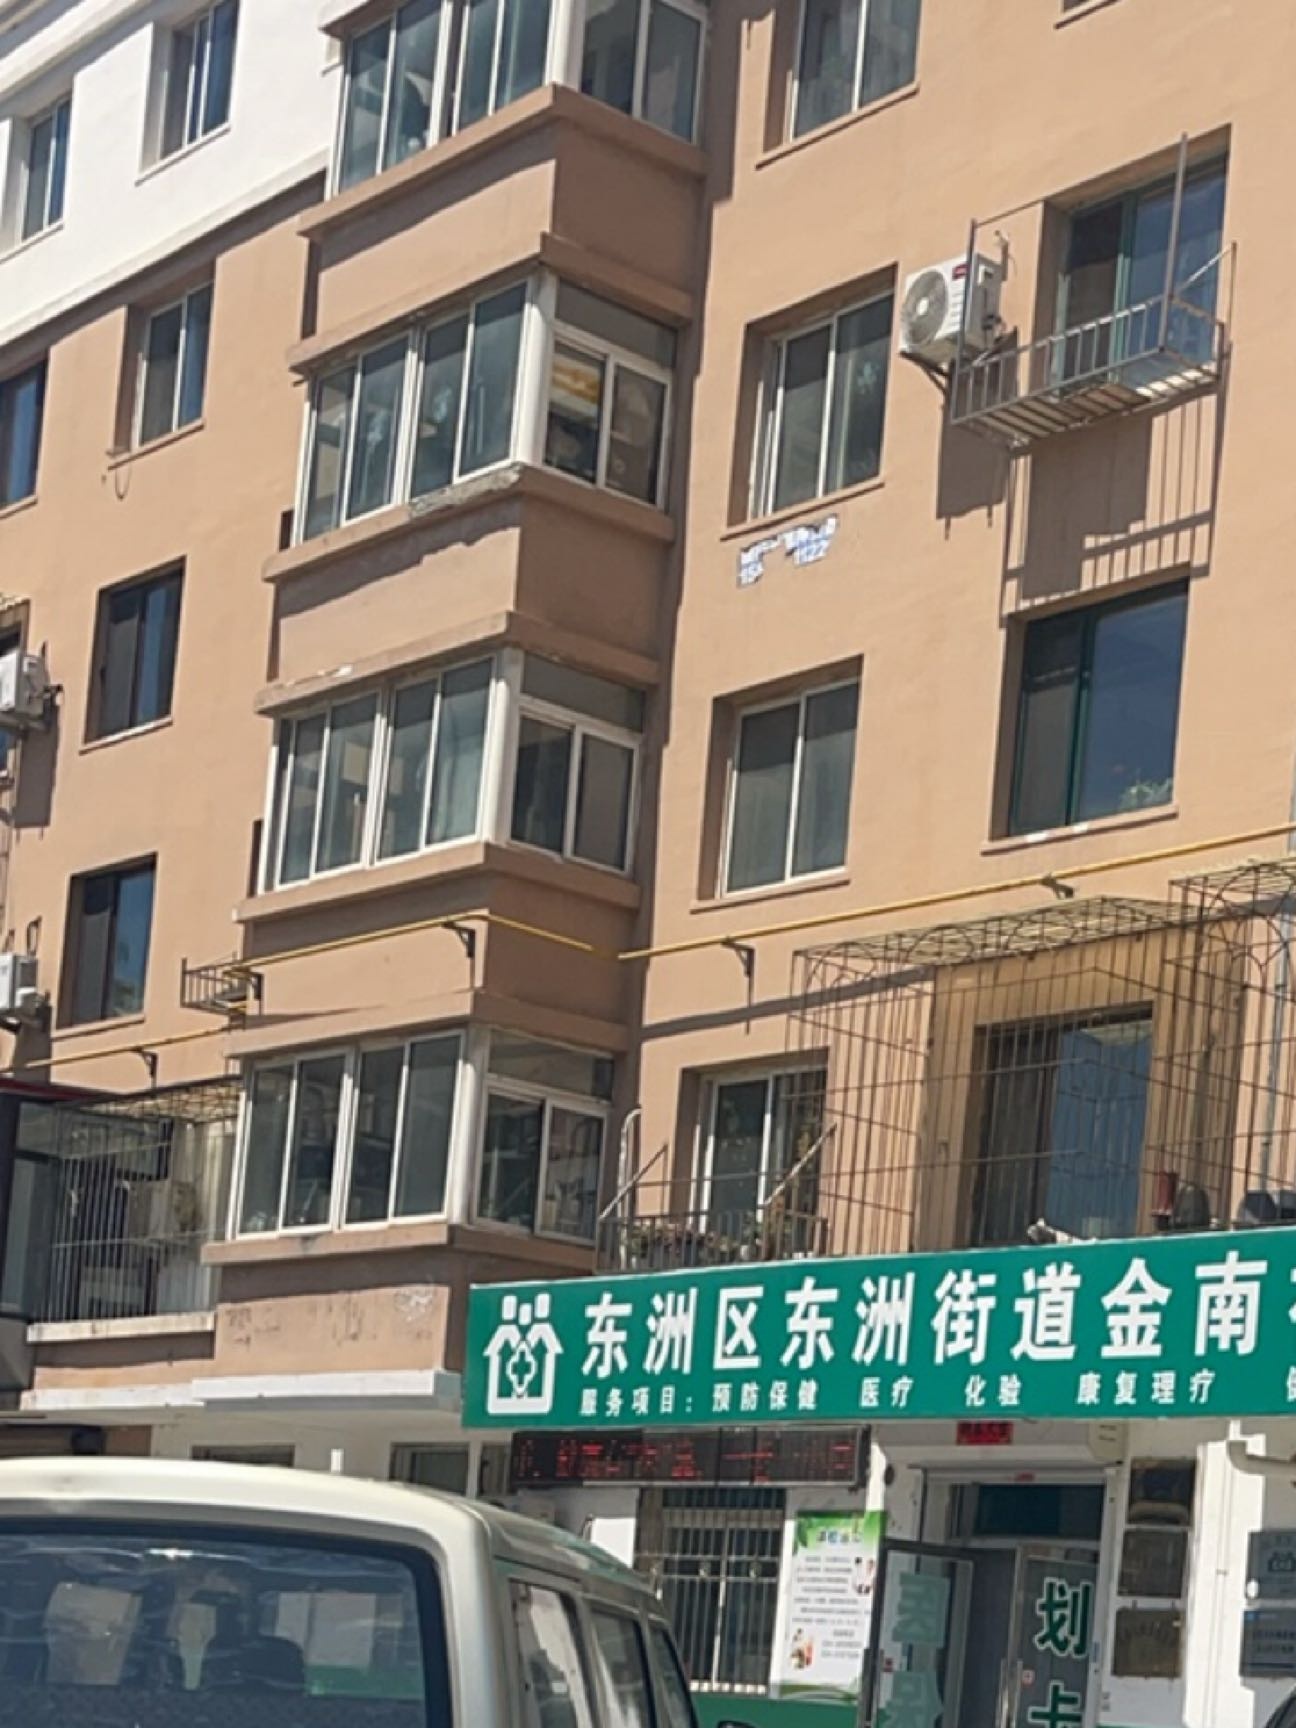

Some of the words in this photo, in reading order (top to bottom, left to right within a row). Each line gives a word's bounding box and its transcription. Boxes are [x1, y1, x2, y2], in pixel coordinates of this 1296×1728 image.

[712, 1379, 819, 1411] 预防保健
[860, 1376, 914, 1408] 医疗
[963, 1373, 1022, 1407] 化验
[1076, 1368, 1215, 1406] 康复理疗
